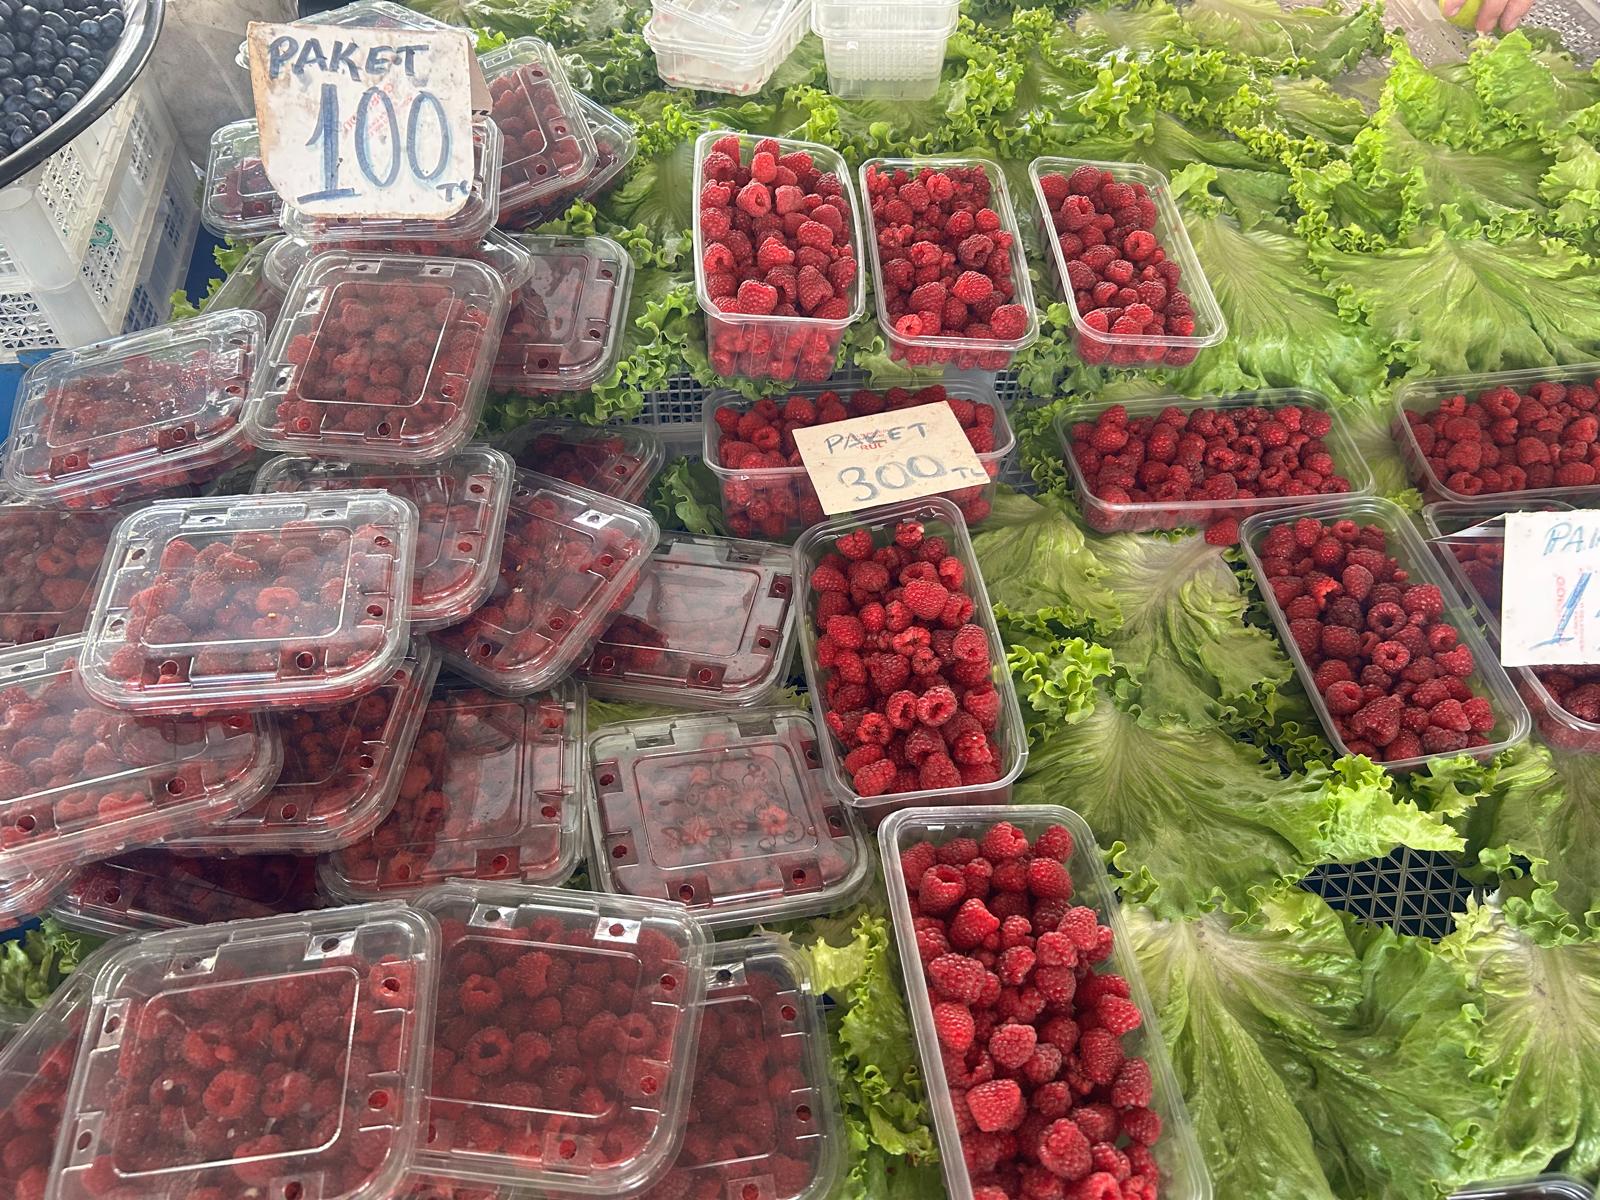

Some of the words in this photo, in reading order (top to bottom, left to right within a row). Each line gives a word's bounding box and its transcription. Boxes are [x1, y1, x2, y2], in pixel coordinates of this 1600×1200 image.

[268, 35, 429, 82] PAKET
[297, 83, 451, 204] 100
[823, 422, 928, 454] PAKET
[838, 454, 947, 502] 300
[951, 467, 986, 480] TL
